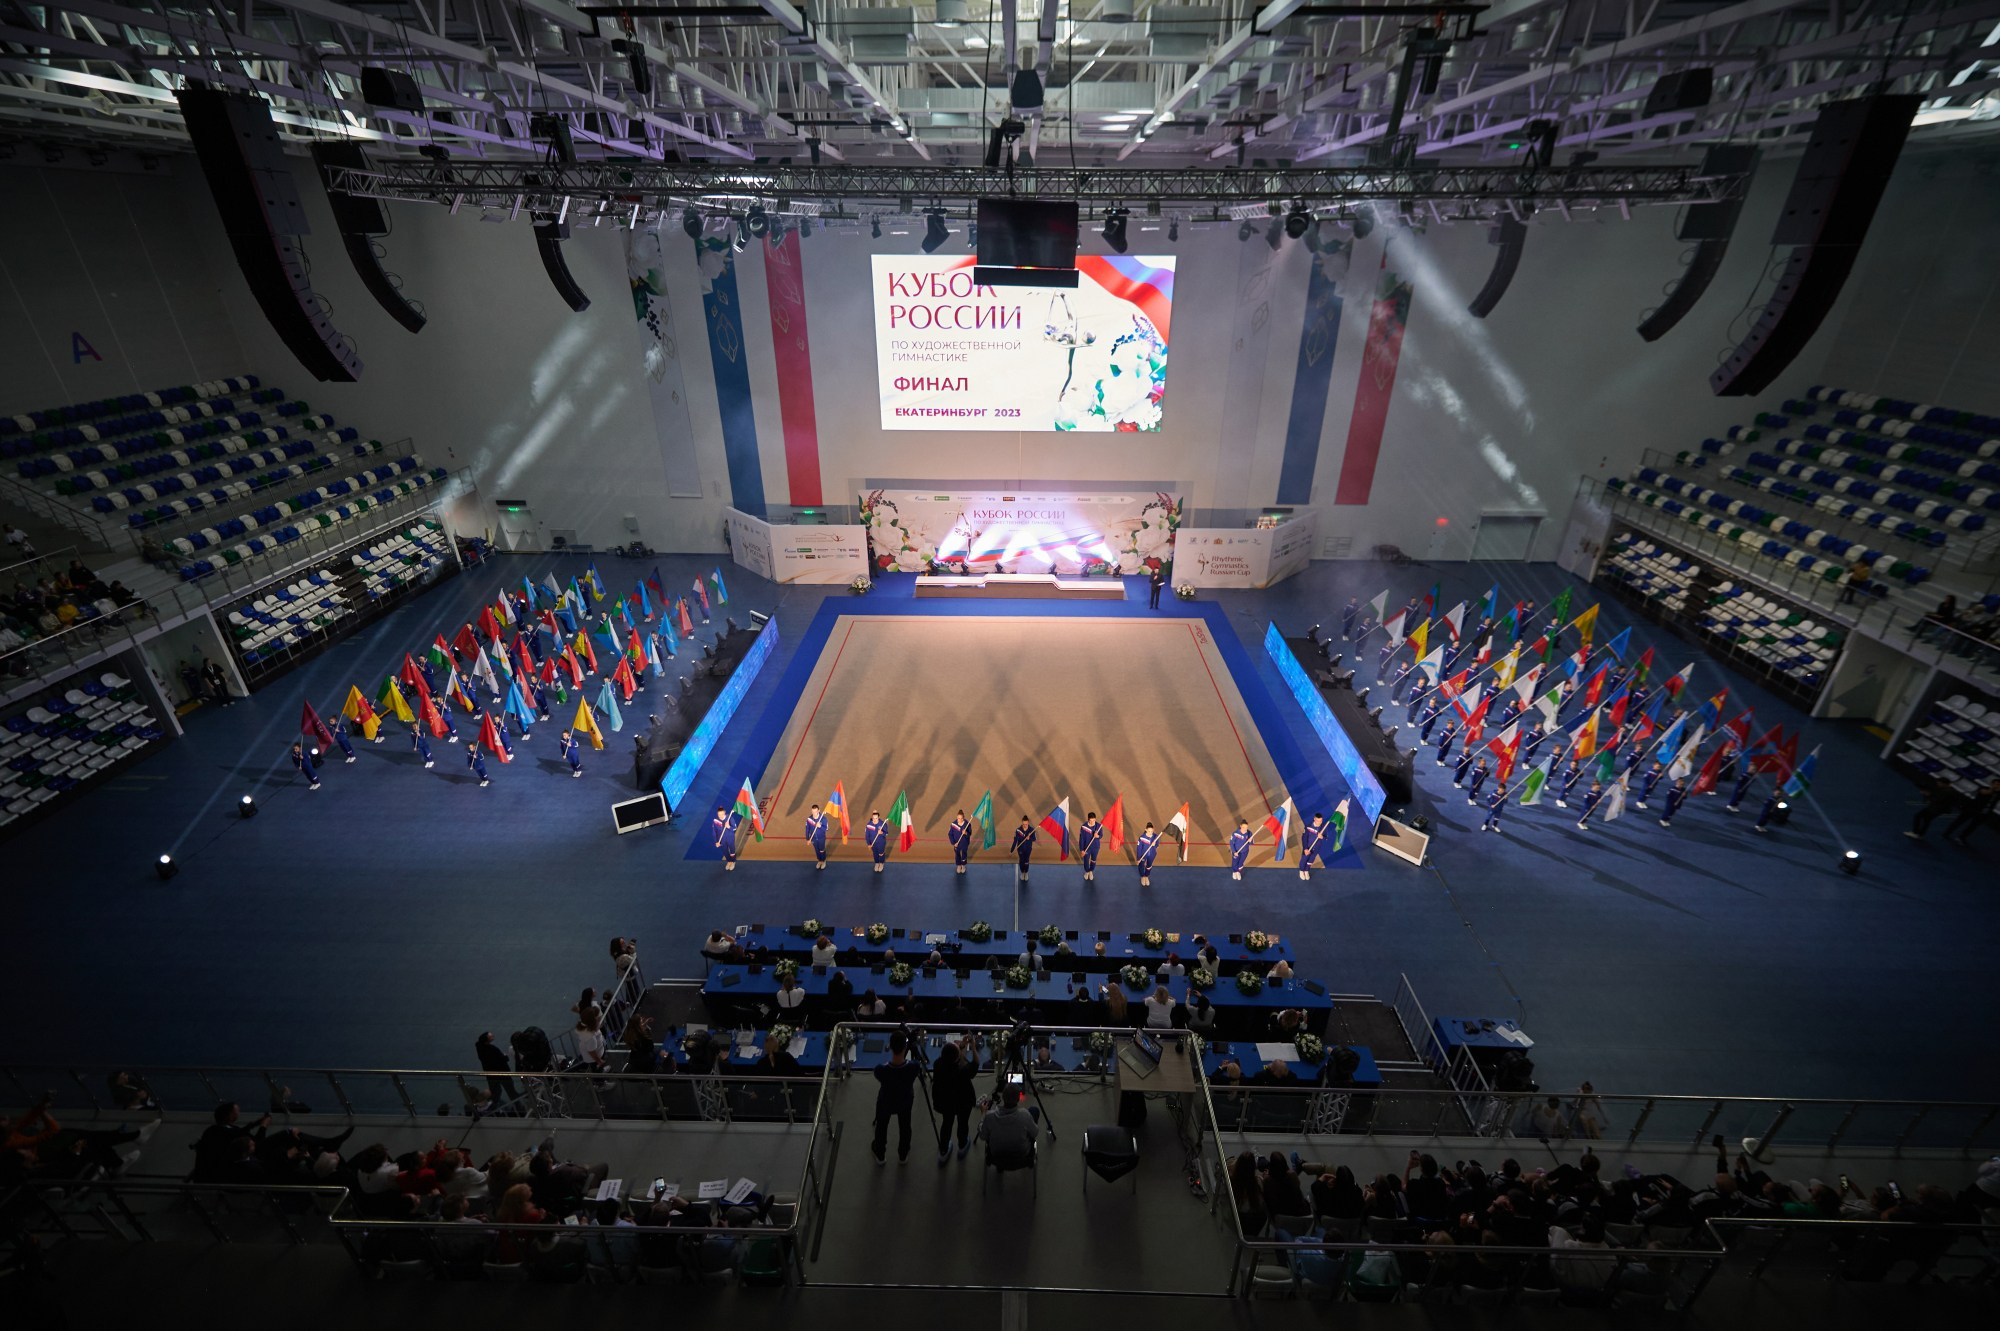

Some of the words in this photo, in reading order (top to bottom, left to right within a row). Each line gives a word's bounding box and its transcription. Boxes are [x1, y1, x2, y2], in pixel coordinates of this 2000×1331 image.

[890, 304, 1021, 330] РОССИИ
[891, 340, 909, 350] ПО
[911, 339, 1021, 351] ХУДОЖЕСТВЕННОЙ
[891, 352, 968, 362] ГИМНАСТИКЕ
[893, 376, 969, 391] ФИНАЛ
[895, 407, 988, 417] ЕКАТЕРИНБУРГ
[994, 408, 1021, 417] 2023
[973, 509, 1012, 519] КУБОК
[1017, 510, 1065, 520] РОССИИ
[1211, 555, 1243, 564] Rhythmic
[1210, 562, 1249, 570] Gymnastics
[1237, 569, 1251, 577] Cup
